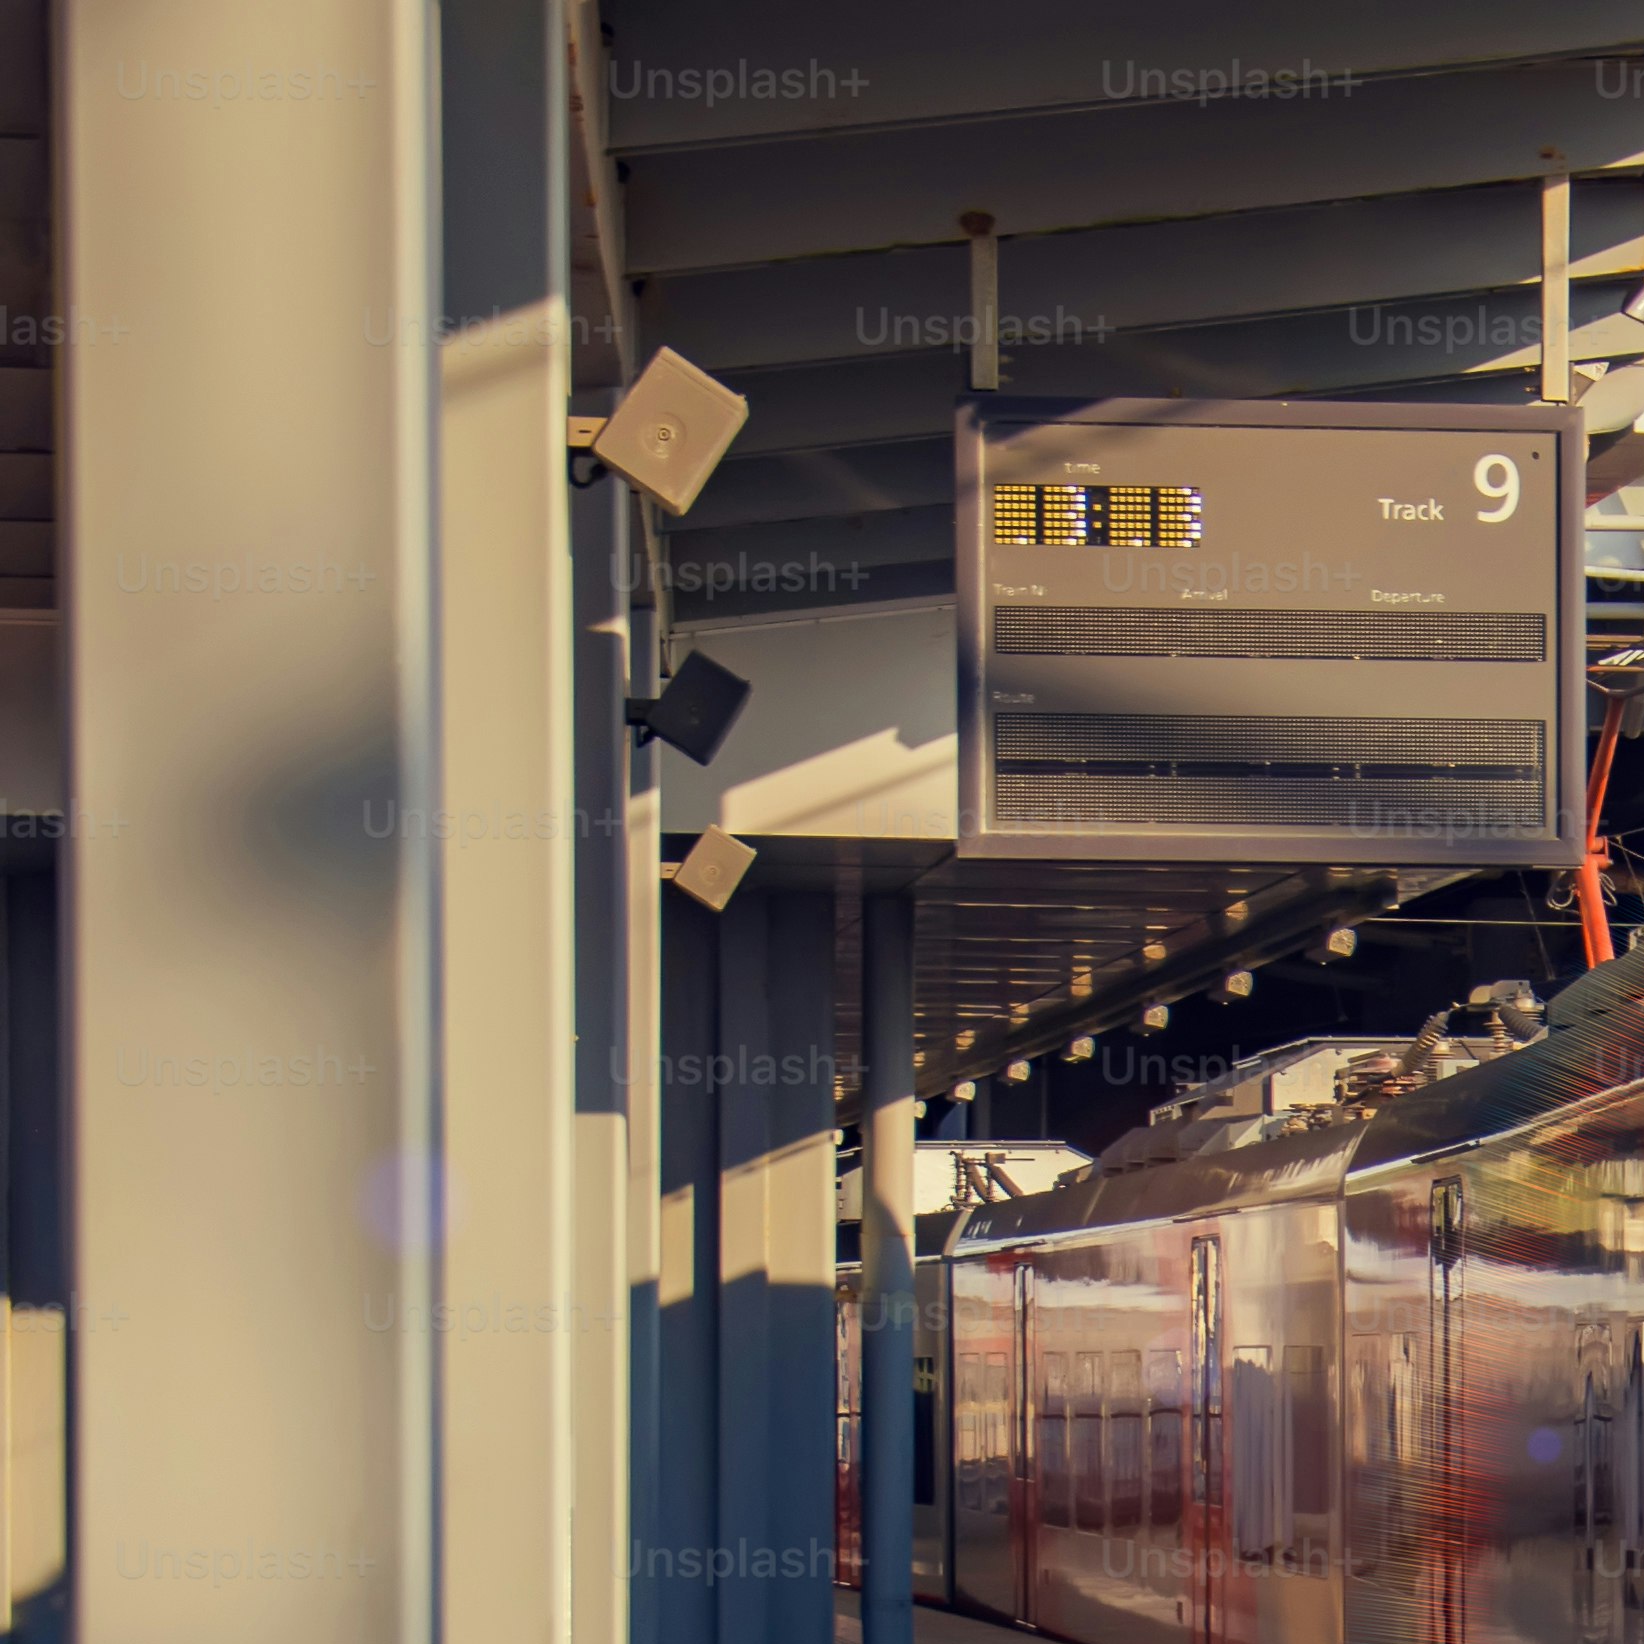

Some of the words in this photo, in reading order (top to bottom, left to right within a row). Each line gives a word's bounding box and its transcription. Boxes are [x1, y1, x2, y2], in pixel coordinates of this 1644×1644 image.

[1377, 498, 1444, 520] Track
[1474, 454, 1520, 523] 9
[1371, 590, 1445, 604] Departure
